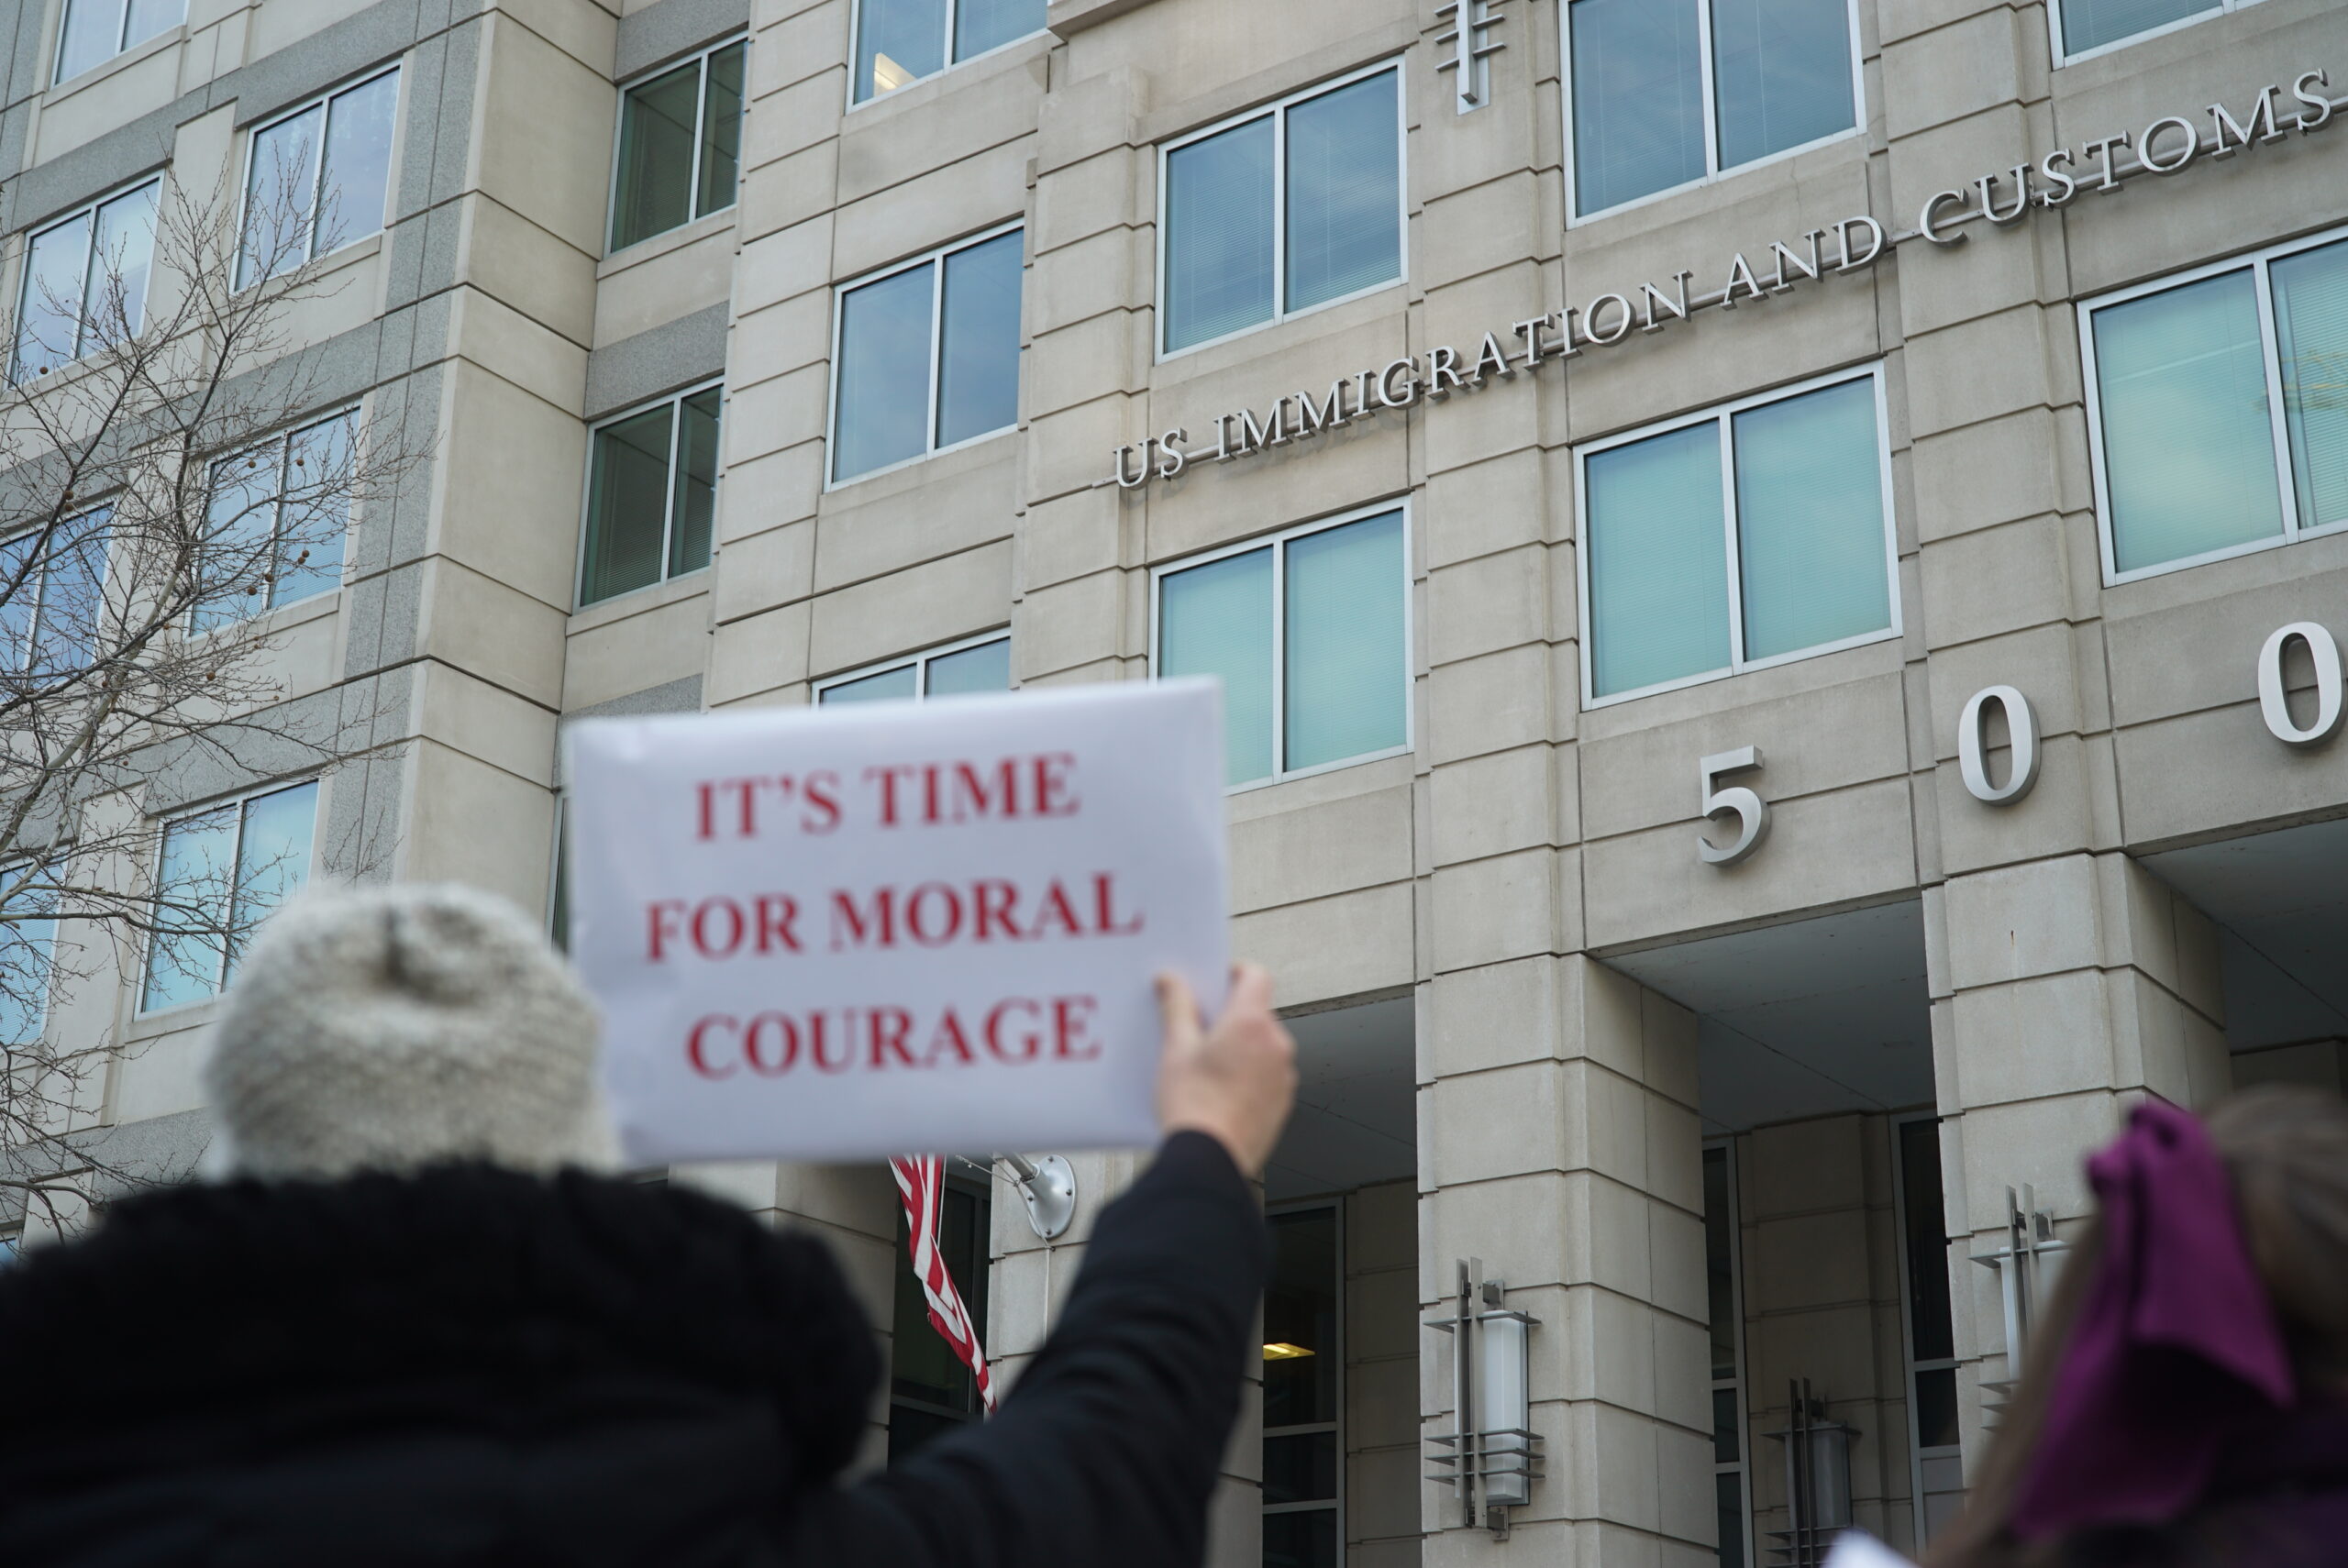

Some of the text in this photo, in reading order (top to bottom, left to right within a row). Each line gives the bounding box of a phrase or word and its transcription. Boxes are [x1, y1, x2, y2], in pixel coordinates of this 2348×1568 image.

[1113, 67, 2335, 490] US IMMIGRATION AND CUSTOMS
[694, 752, 1081, 842] IT'S TIME
[645, 871, 1145, 964] FOR MORAL
[685, 995, 1103, 1081] COURAGE
